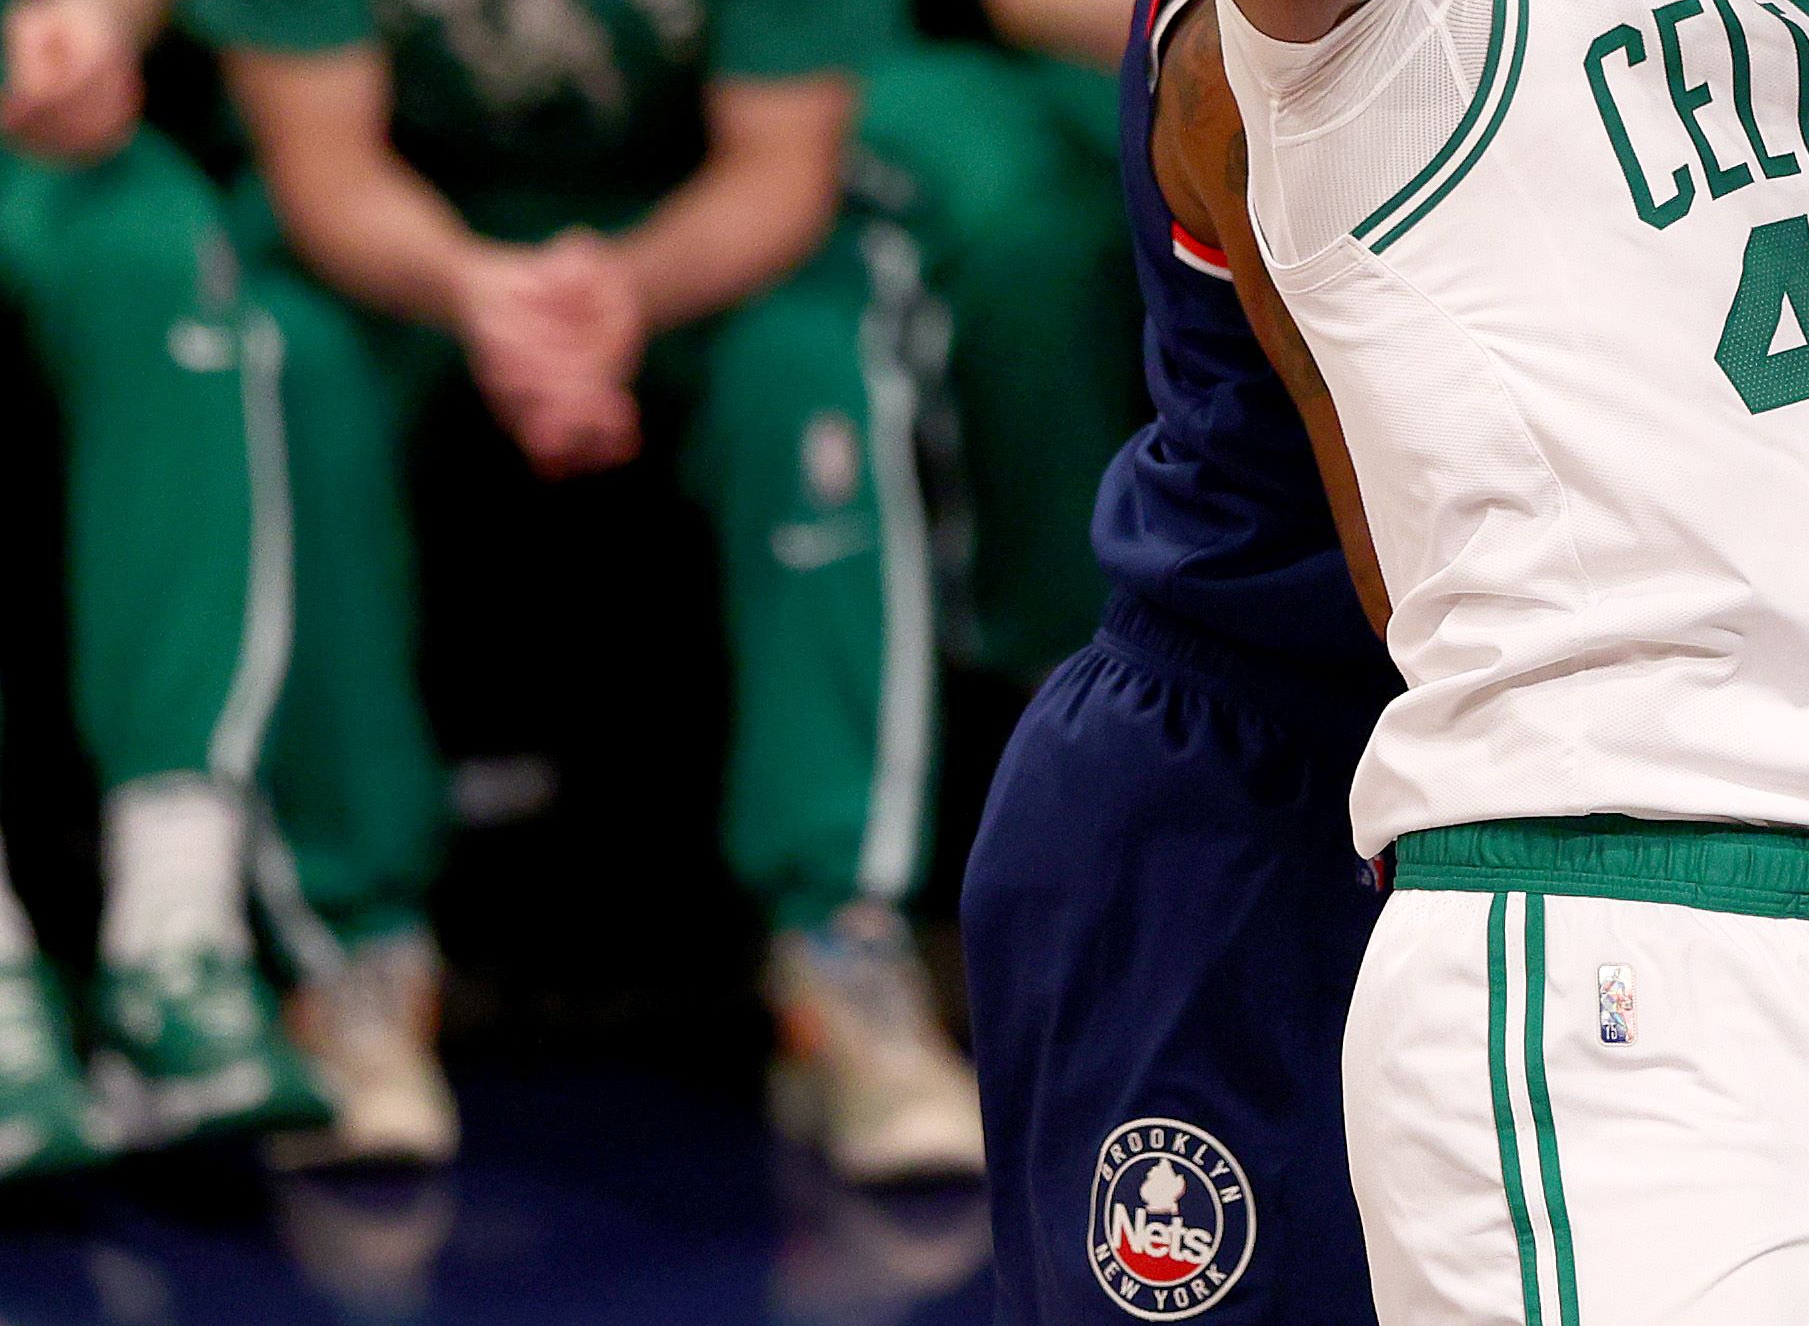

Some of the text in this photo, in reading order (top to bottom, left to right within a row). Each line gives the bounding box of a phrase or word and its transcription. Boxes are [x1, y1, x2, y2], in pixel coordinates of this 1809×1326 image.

[1100, 1128, 1242, 1204] BROOKLYN
[1111, 1202, 1215, 1265] Nets
[1095, 1243, 1228, 1311] NEW YORK
